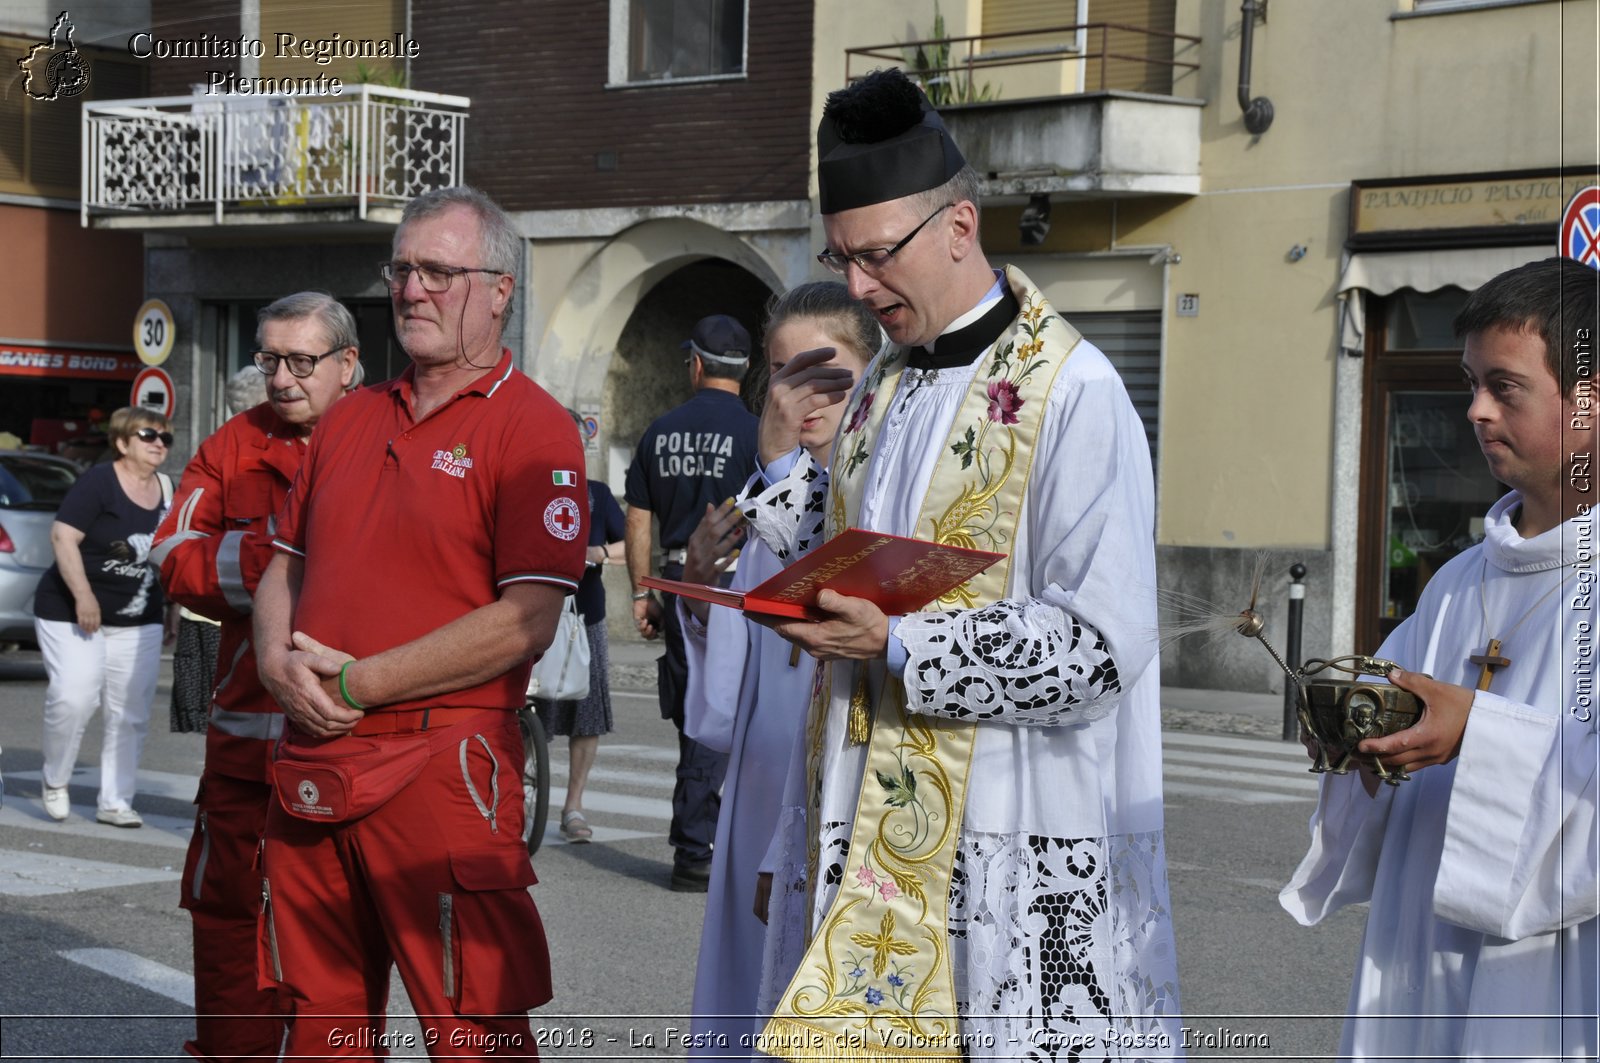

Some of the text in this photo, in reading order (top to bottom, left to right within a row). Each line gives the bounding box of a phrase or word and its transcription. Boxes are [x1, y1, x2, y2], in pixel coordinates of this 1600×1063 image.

[1363, 187, 1473, 209] PANIFICIO
[144, 318, 165, 347] 30
[68, 356, 118, 371] BOND
[655, 432, 733, 457] POLIZIA
[659, 455, 726, 478] LOCALE
[802, 555, 850, 582] DELLA
